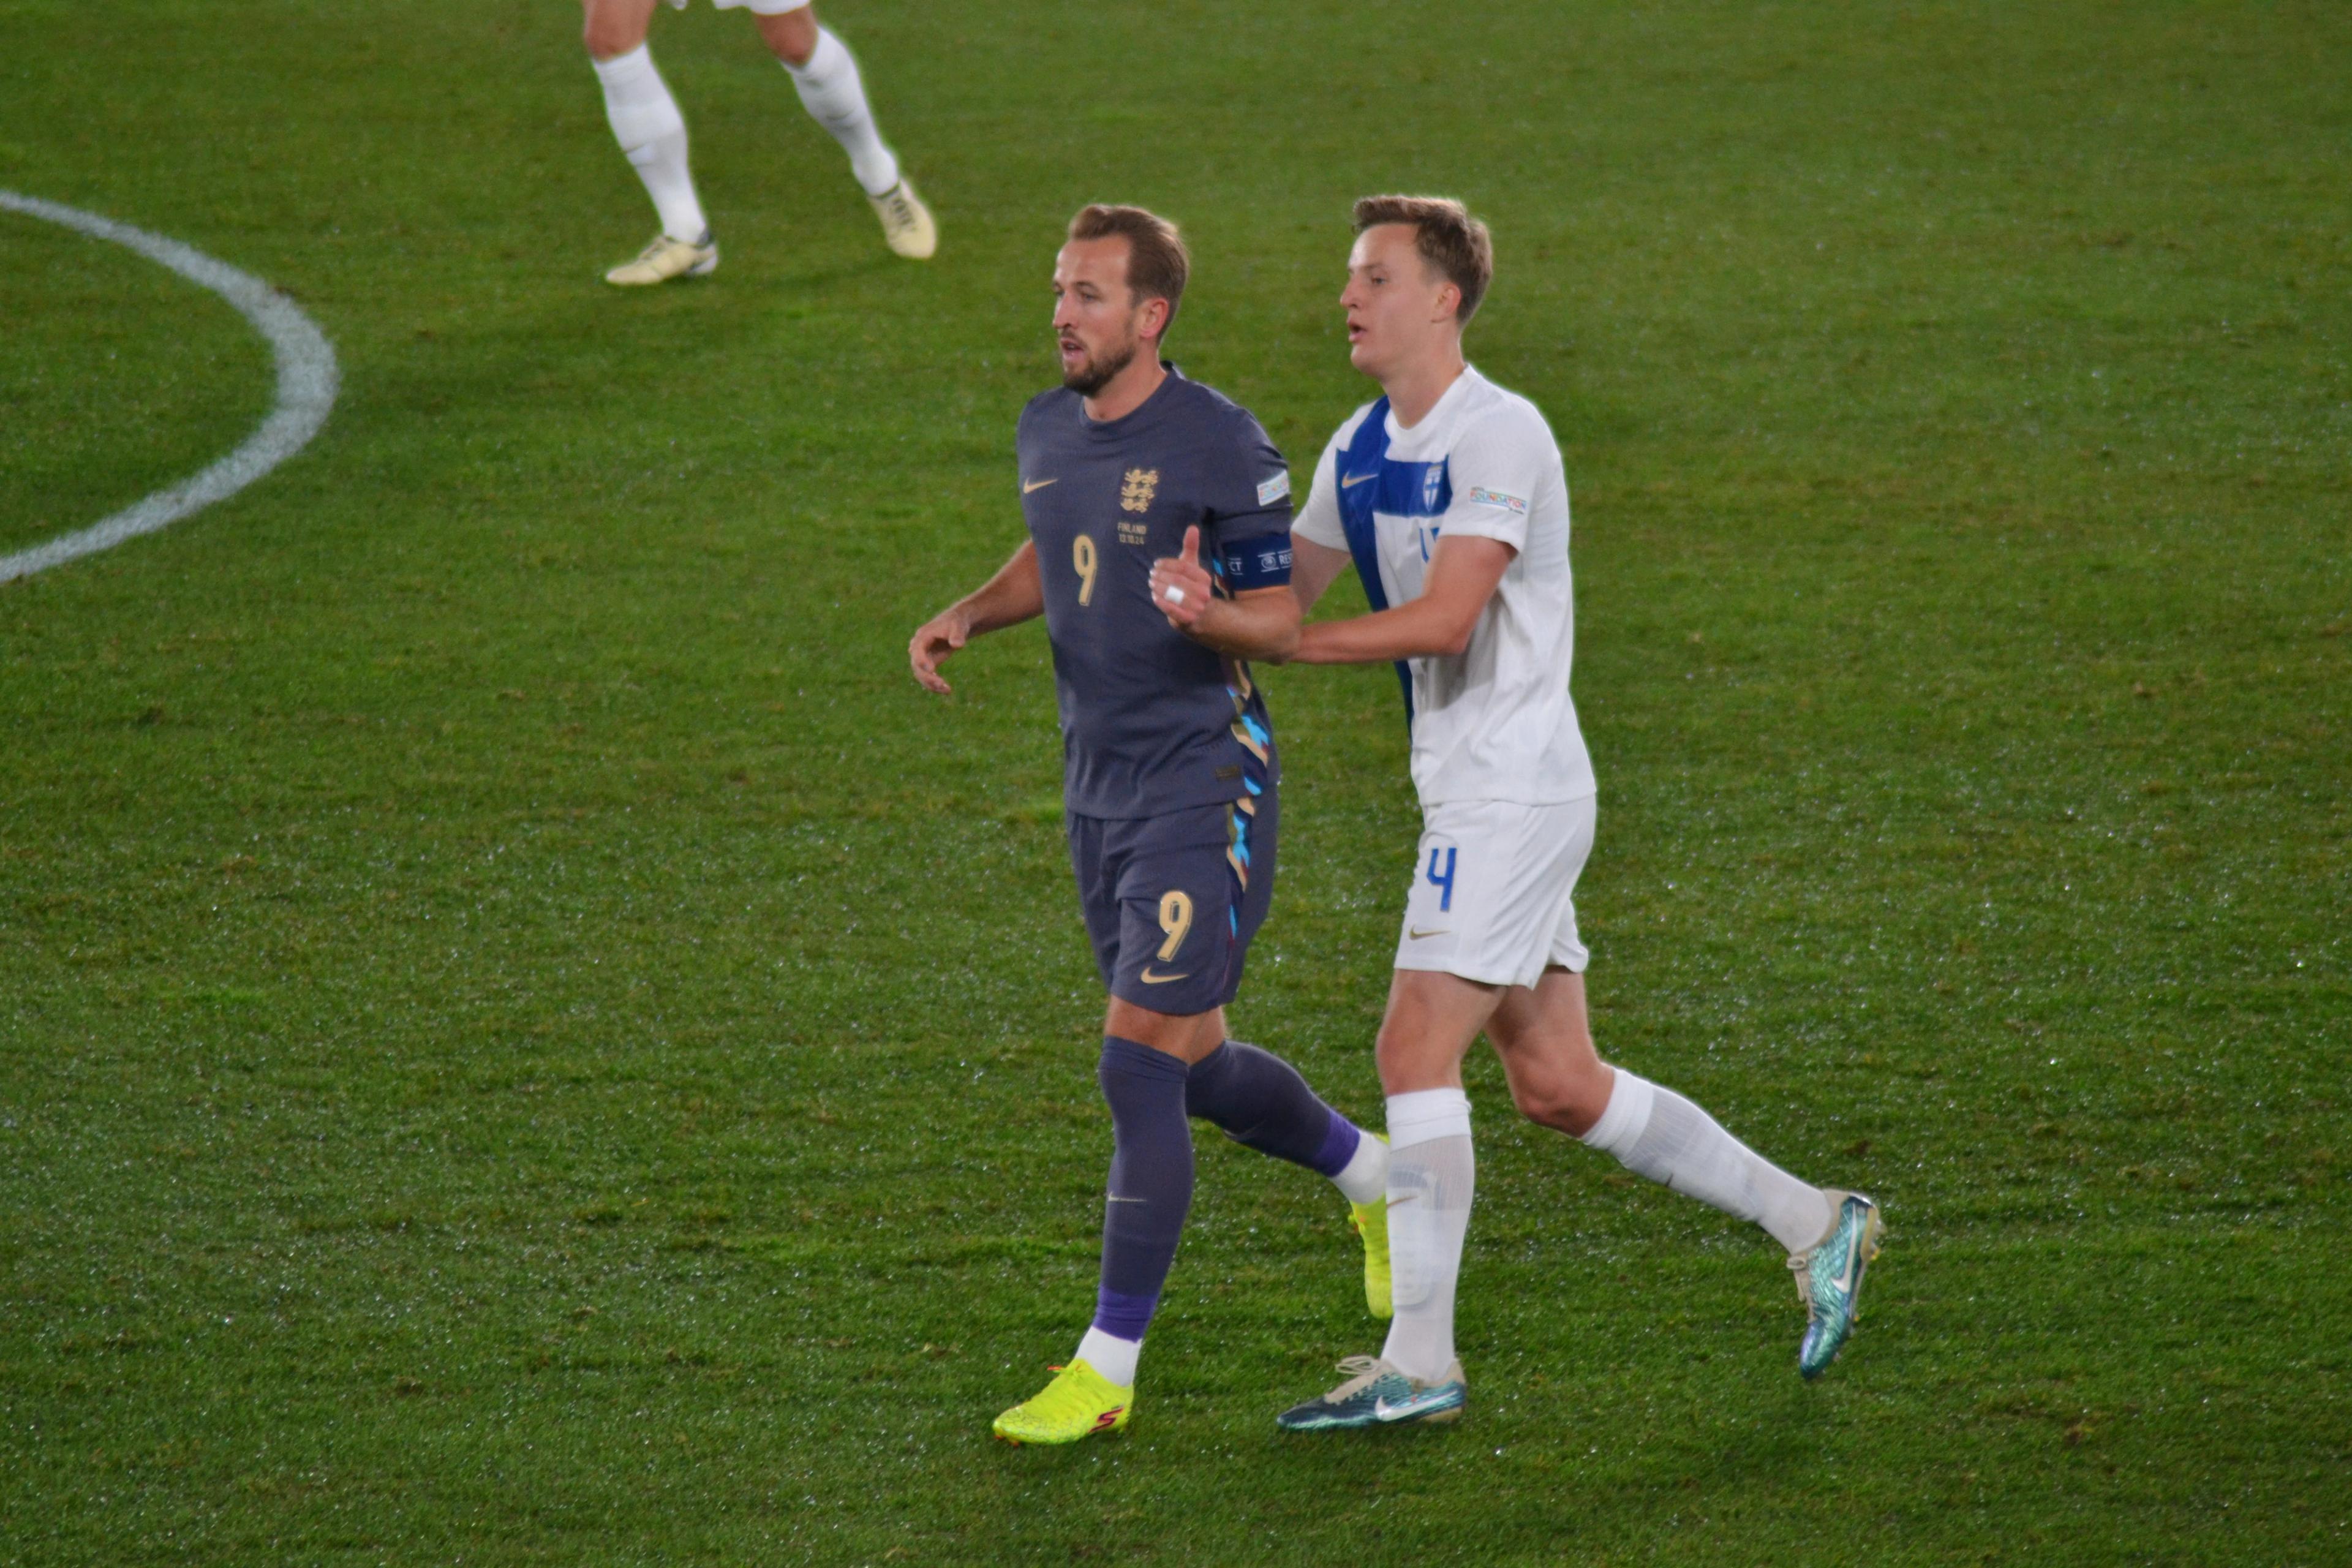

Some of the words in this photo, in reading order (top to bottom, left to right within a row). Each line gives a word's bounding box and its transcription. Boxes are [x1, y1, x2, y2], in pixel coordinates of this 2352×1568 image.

[1117, 522, 1147, 535] FINLAND
[1073, 534, 1097, 606] 9
[1426, 848, 1457, 913] 4
[1156, 891, 1193, 962] 9
